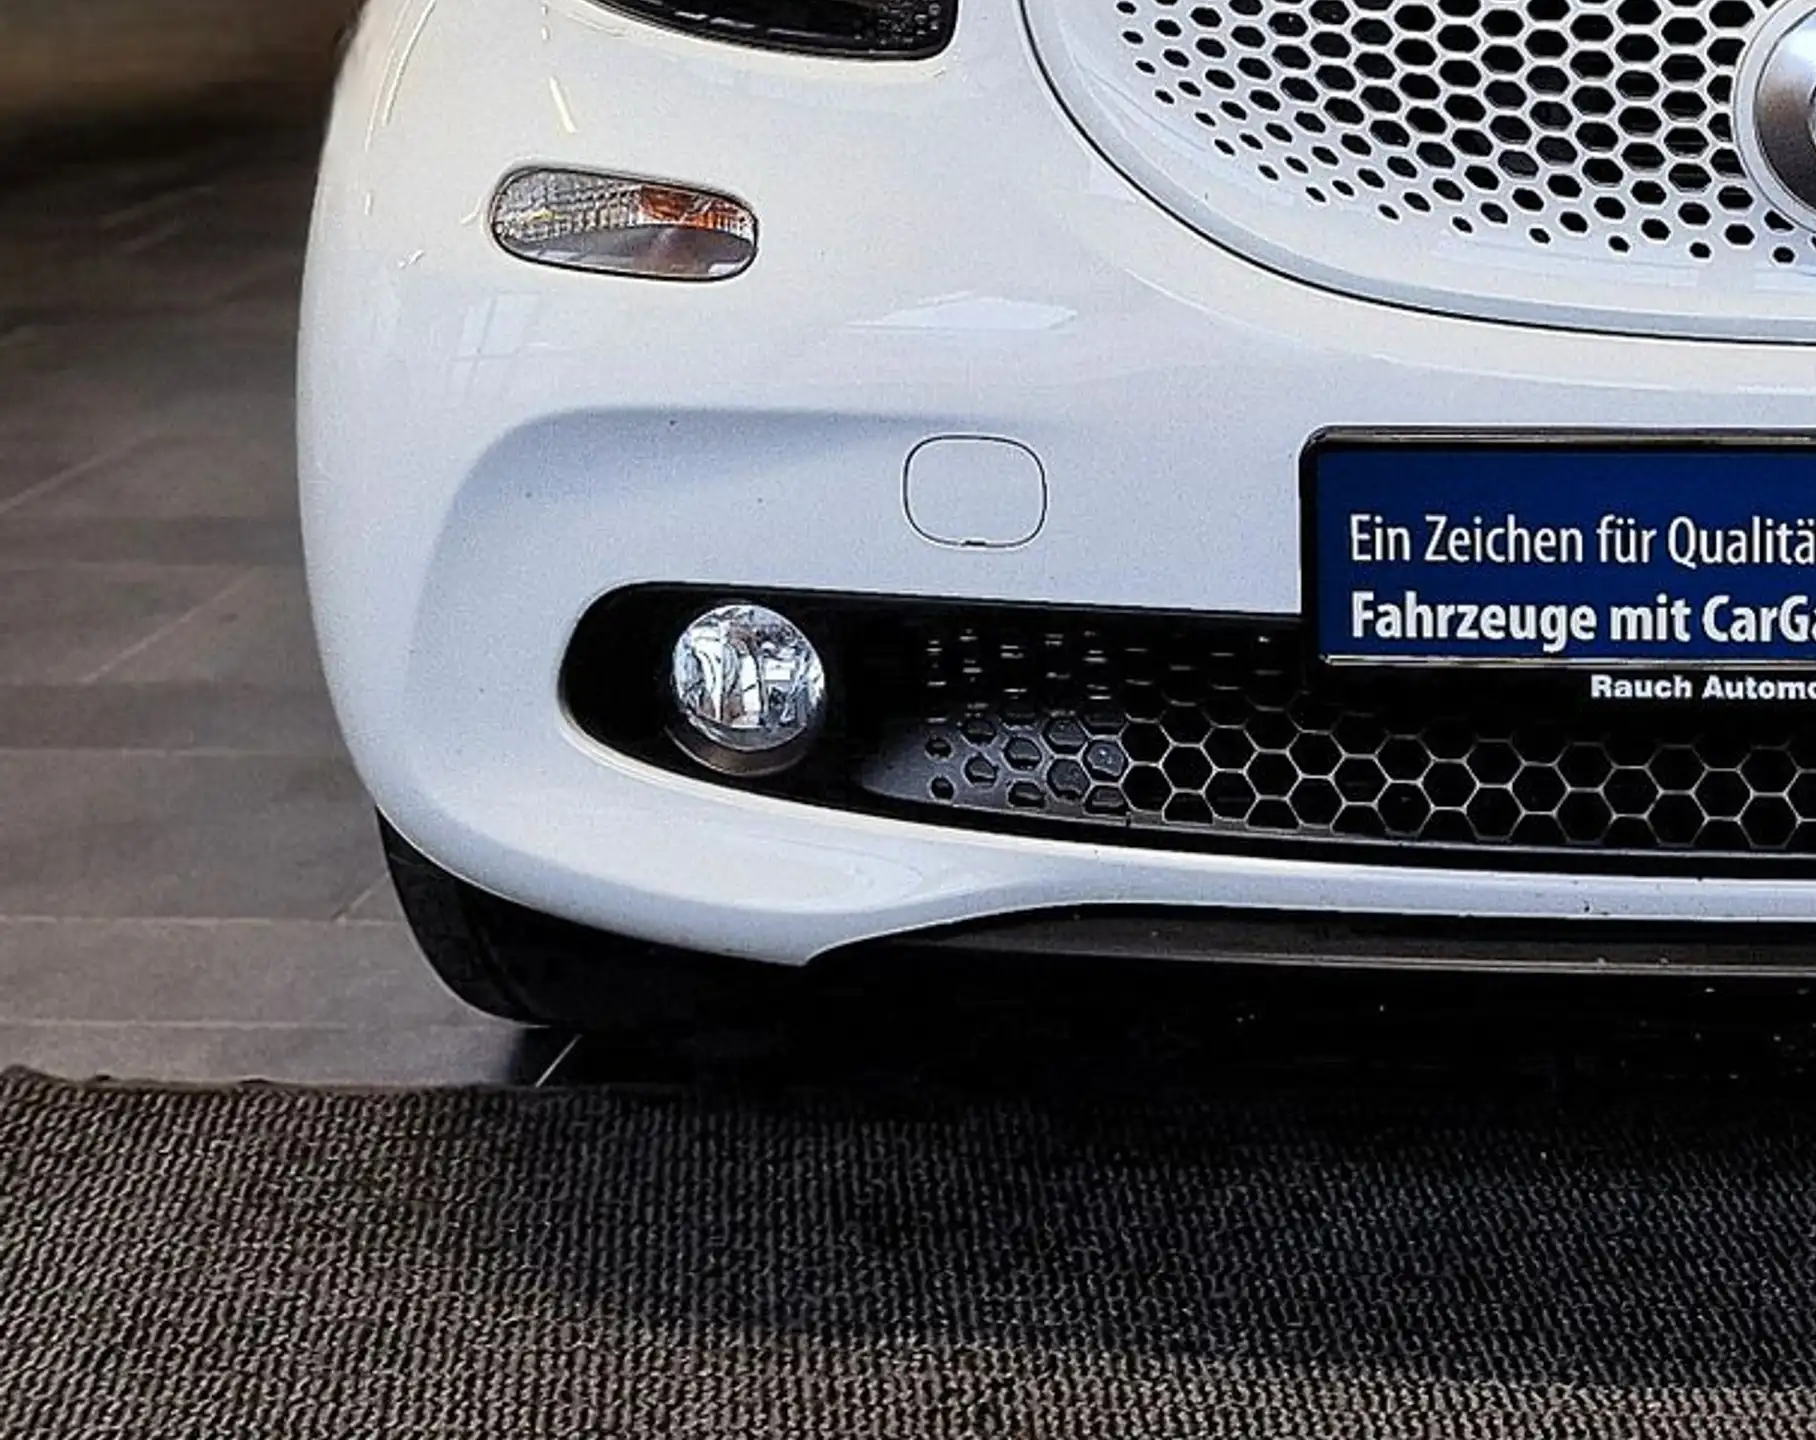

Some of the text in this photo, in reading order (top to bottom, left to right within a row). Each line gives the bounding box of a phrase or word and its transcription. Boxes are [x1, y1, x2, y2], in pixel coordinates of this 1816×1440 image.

[1351, 514, 1411, 561] Ein
[1425, 514, 1583, 563] Zeichen
[1597, 514, 1658, 563] für
[1352, 591, 1597, 653] Fahrzeuge
[1611, 594, 1692, 642] mit
[1591, 674, 1693, 699] Rauch
